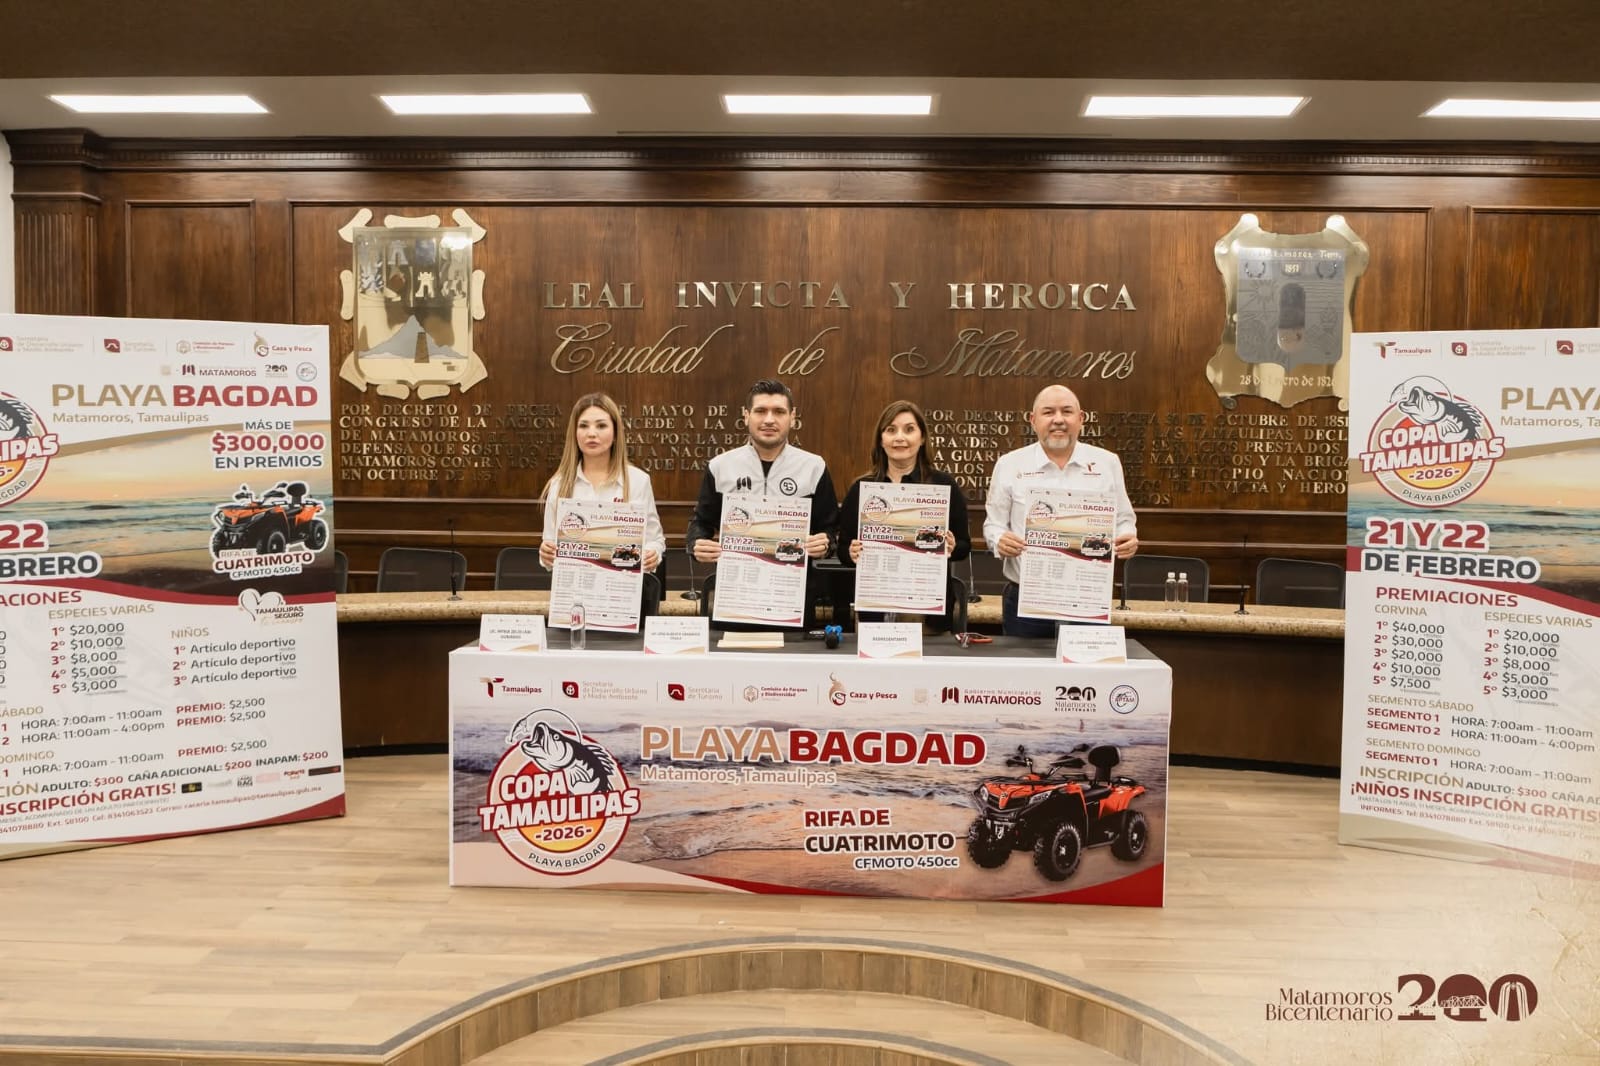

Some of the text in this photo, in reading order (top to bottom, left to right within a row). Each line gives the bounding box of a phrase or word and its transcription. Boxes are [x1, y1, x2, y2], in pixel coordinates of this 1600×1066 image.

[544, 282, 1136, 310] LEAL INVICTA Y HEROICA
[550, 322, 1136, 380] Ciudad de Matamoros
[52, 384, 318, 406] PLAYA BAGDAD
[52, 412, 209, 424] Matamoros, Tamaulipas
[341, 404, 458, 416] POR DECRETO
[642, 404, 728, 417] MAYO DE
[924, 410, 954, 422] POR
[245, 418, 292, 430] MÁS DE
[340, 416, 487, 428] CONGRESO DE LA
[704, 418, 725, 430] LA
[1297, 415, 1316, 426] DE
[1500, 416, 1582, 428] Matamoros,
[340, 430, 361, 442] DE
[370, 430, 480, 442] MATAMOROS
[928, 424, 1009, 436] CONGRESO
[1380, 425, 1438, 448] COPA
[212, 434, 324, 454] $300,000
[340, 443, 414, 455] DEFENSA
[1246, 442, 1340, 454] PRESTADOS
[216, 456, 322, 468] EN PREMIOS
[340, 456, 436, 468] MATAMOROS
[1276, 456, 1296, 466] LA
[1360, 438, 1504, 472] TAMAULIPAS
[342, 470, 438, 480] EN OCTUBRE
[1403, 482, 1472, 501] PLAYA BAGDAD
[1369, 520, 1485, 548] 21 Y 22
[215, 552, 312, 571] CUATRIMOTO
[1364, 553, 1536, 579] DE FEBRERO
[232, 566, 300, 578] CFMOTO 450cc
[1376, 587, 1518, 608] PREMIACIONES
[48, 604, 154, 620] ESPECIES VARIAS
[256, 606, 304, 614] TAMAULIPAS
[1375, 604, 1592, 628] CORVINA ESPECIES VARIAS
[70, 622, 124, 636] $20,000
[1392, 622, 1560, 644] $40,000 $20,000
[70, 636, 123, 650] $10,000
[240, 638, 296, 651] deportivo
[1392, 636, 1556, 658] $30,000 $10,000
[70, 651, 117, 665] $8,000
[240, 653, 296, 666] deportivo
[1392, 650, 1550, 672] $20,000 $8,000
[72, 665, 117, 680] $5,000
[241, 667, 296, 680] deportivo
[1391, 663, 1548, 686] $10,000 $5,000
[72, 679, 117, 694] $3,000
[502, 686, 542, 694] Tamaulipas
[1056, 686, 1096, 700] 200
[1390, 677, 1548, 700] $7,500 $3,000
[964, 696, 1041, 706] MATAMOROS
[1368, 694, 1474, 712] SEGMENTO SÁBADO
[21, 698, 266, 730] HORA: 7:00am 11:00am PREMIO: $2,500
[1368, 708, 1592, 738] SEGMENTO HORA: 7:00am 11:00am
[1367, 720, 1594, 752] SEGMENTO 2 HORA: 11:00am 4:00pm
[178, 740, 267, 757] PREMIO: $2,500
[642, 727, 986, 764] PLAYA BAGDAD
[1366, 738, 1480, 757] SEGMENTO DOMINGO
[41, 751, 328, 792] ADULTO: $300 CAÑA ADICIONAL: $200 INAPAM: $200
[1366, 750, 1592, 784] SEGMENTO HORA: 7:00am 11:00am
[642, 767, 835, 786] Matamoros, Tamaulipas
[109, 782, 176, 802] GRATIS!
[501, 772, 568, 801] COPA
[1360, 766, 1585, 804] INSCRIPCIÓN ADULTO: $300 CAÑA
[1351, 782, 1526, 814] ¡NIÑOS INSCRIPCIÓN
[480, 790, 640, 831] TAMAULIPAS
[805, 810, 890, 826] RIFA DE
[1360, 805, 1402, 816] INFORMES:
[806, 834, 954, 852] CUATRIMOTO
[528, 843, 606, 867] PLAYA BAGDAD
[855, 856, 958, 868] CFMOTO 450cc
